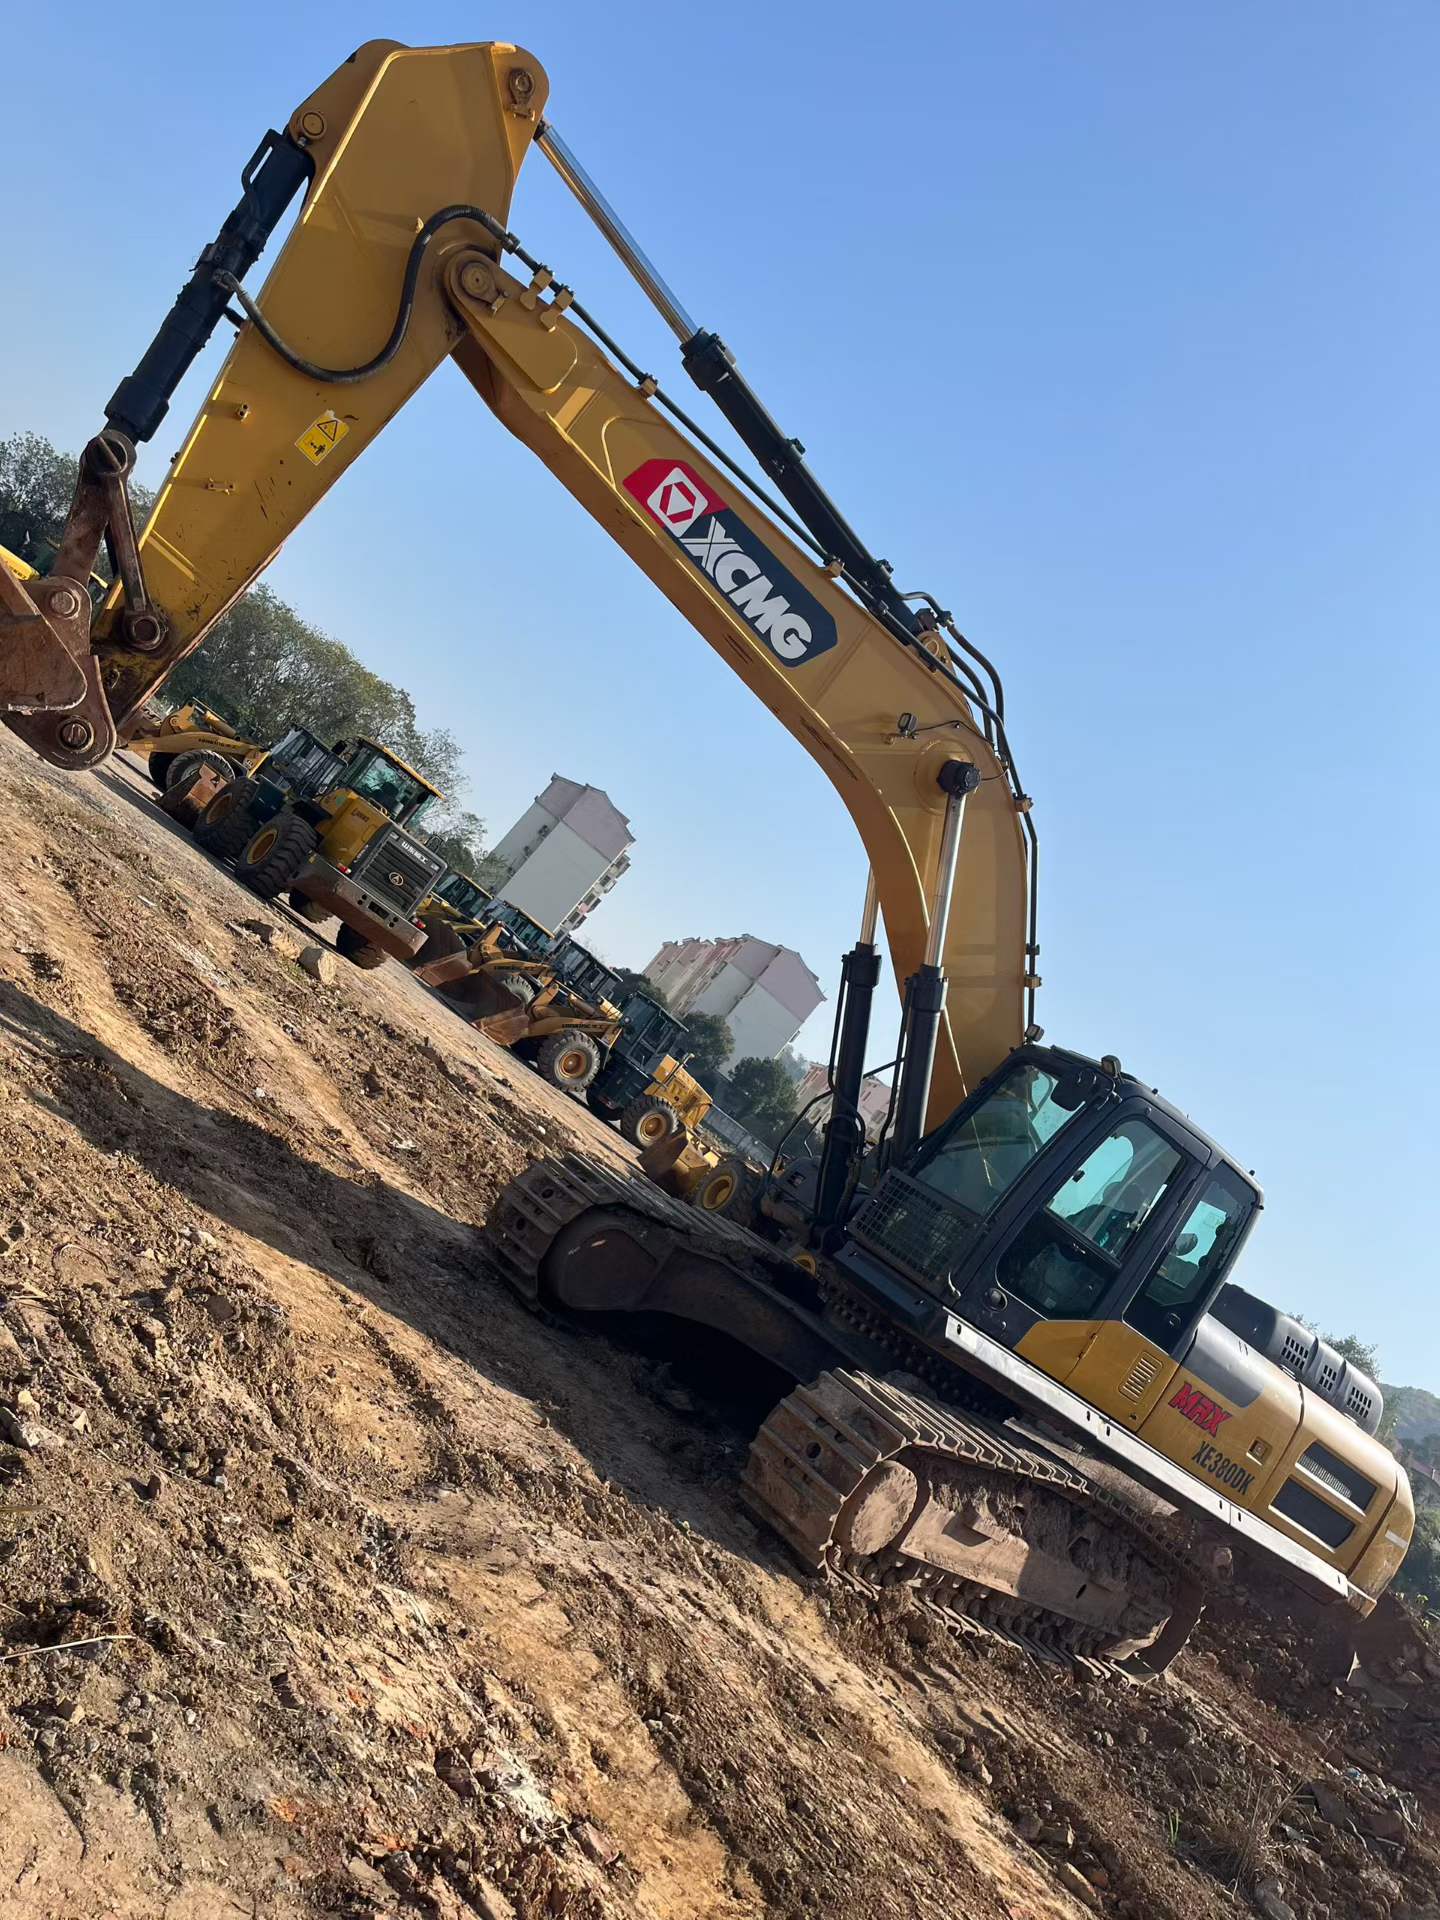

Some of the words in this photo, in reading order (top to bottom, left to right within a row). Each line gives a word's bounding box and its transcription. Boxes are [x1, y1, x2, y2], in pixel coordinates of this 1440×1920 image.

[679, 516, 812, 659] XCMG
[1168, 1381, 1232, 1437] MAX
[1192, 1441, 1255, 1495] XE380DK
